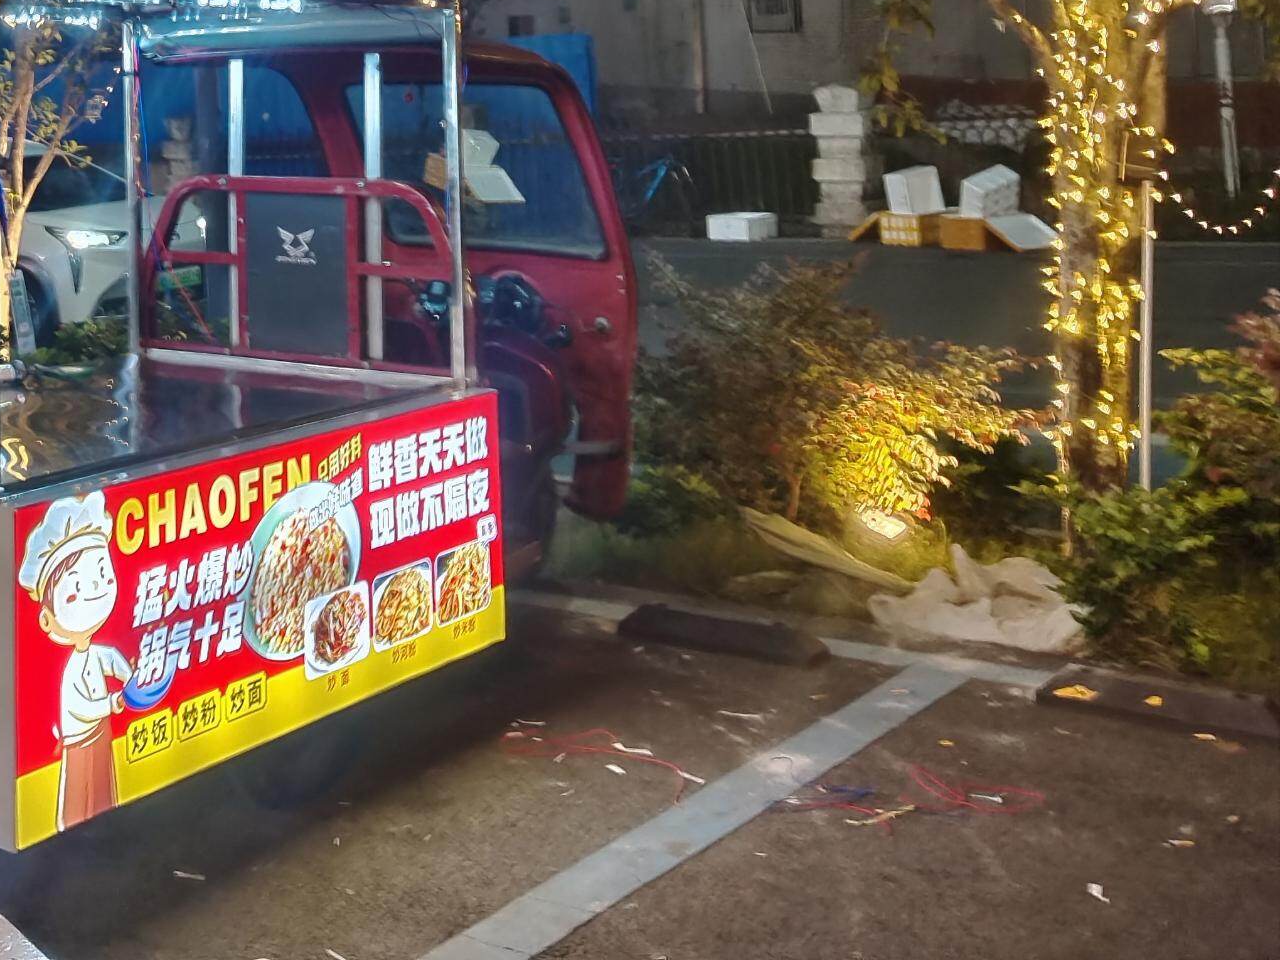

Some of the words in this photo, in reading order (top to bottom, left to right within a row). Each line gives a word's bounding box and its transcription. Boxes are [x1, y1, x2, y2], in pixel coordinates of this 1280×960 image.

[368, 416, 488, 492] 鲜香天天做
[116, 453, 312, 556] CHAOFEN
[370, 468, 490, 549] 现做不隔夜
[132, 540, 254, 628] 猛火爆炒
[137, 601, 246, 687] 锅气十足
[131, 716, 169, 766] 炒饭
[182, 695, 217, 734] 炒粉
[230, 678, 263, 714] 炒面
